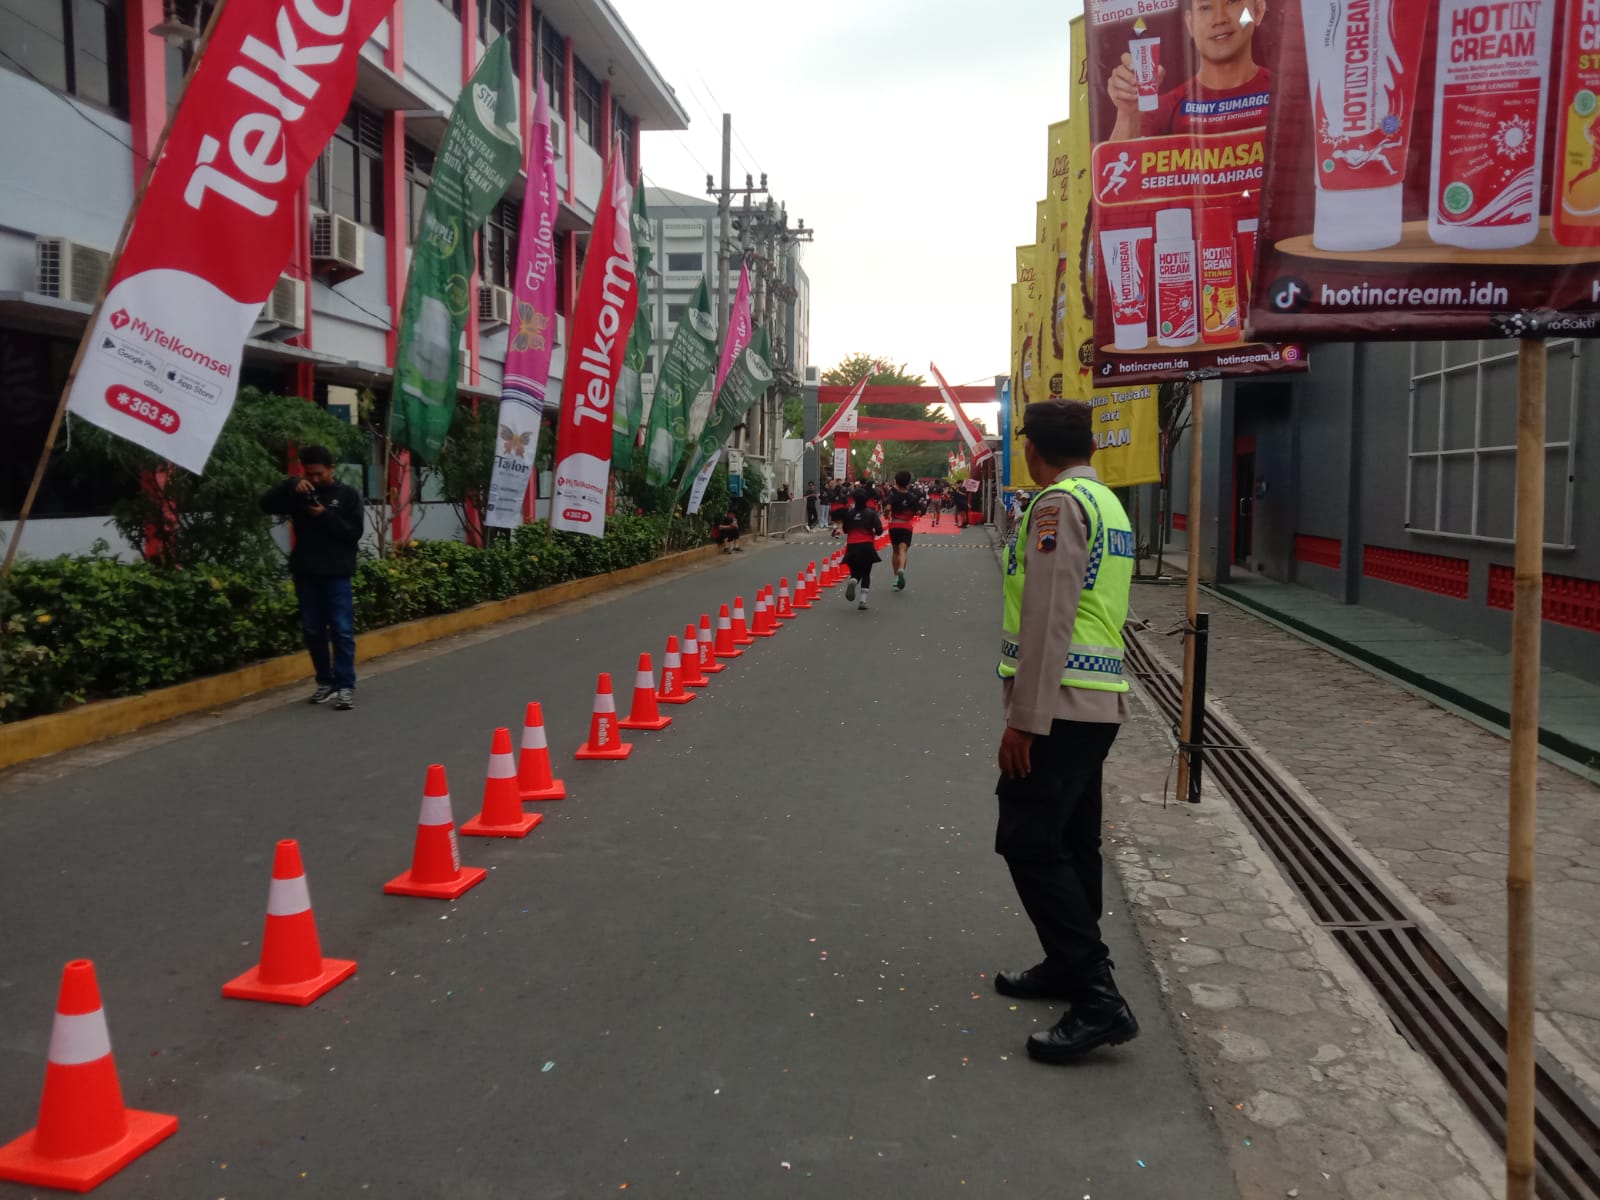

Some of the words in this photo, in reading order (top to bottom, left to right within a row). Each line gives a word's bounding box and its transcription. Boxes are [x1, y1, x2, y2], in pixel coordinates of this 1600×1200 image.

[1096, 7, 1133, 23] Tanpa
[1137, 0, 1176, 15] Bekas
[1450, 31, 1535, 63] CREAM
[1185, 102, 1217, 113] DENNY
[474, 157, 505, 189] DENGAN
[1142, 173, 1200, 190] SEBELUM
[525, 211, 551, 291] Taylor
[1160, 263, 1190, 275] CREAM
[1204, 259, 1232, 270] CREAM
[1321, 281, 1509, 307] hotincream.idn
[117, 347, 143, 366] Google
[130, 317, 231, 379] MyTelkomsel
[1119, 359, 1189, 374] hotincream.idn
[1217, 351, 1280, 366] hotincream.id
[143, 379, 163, 395] atau
